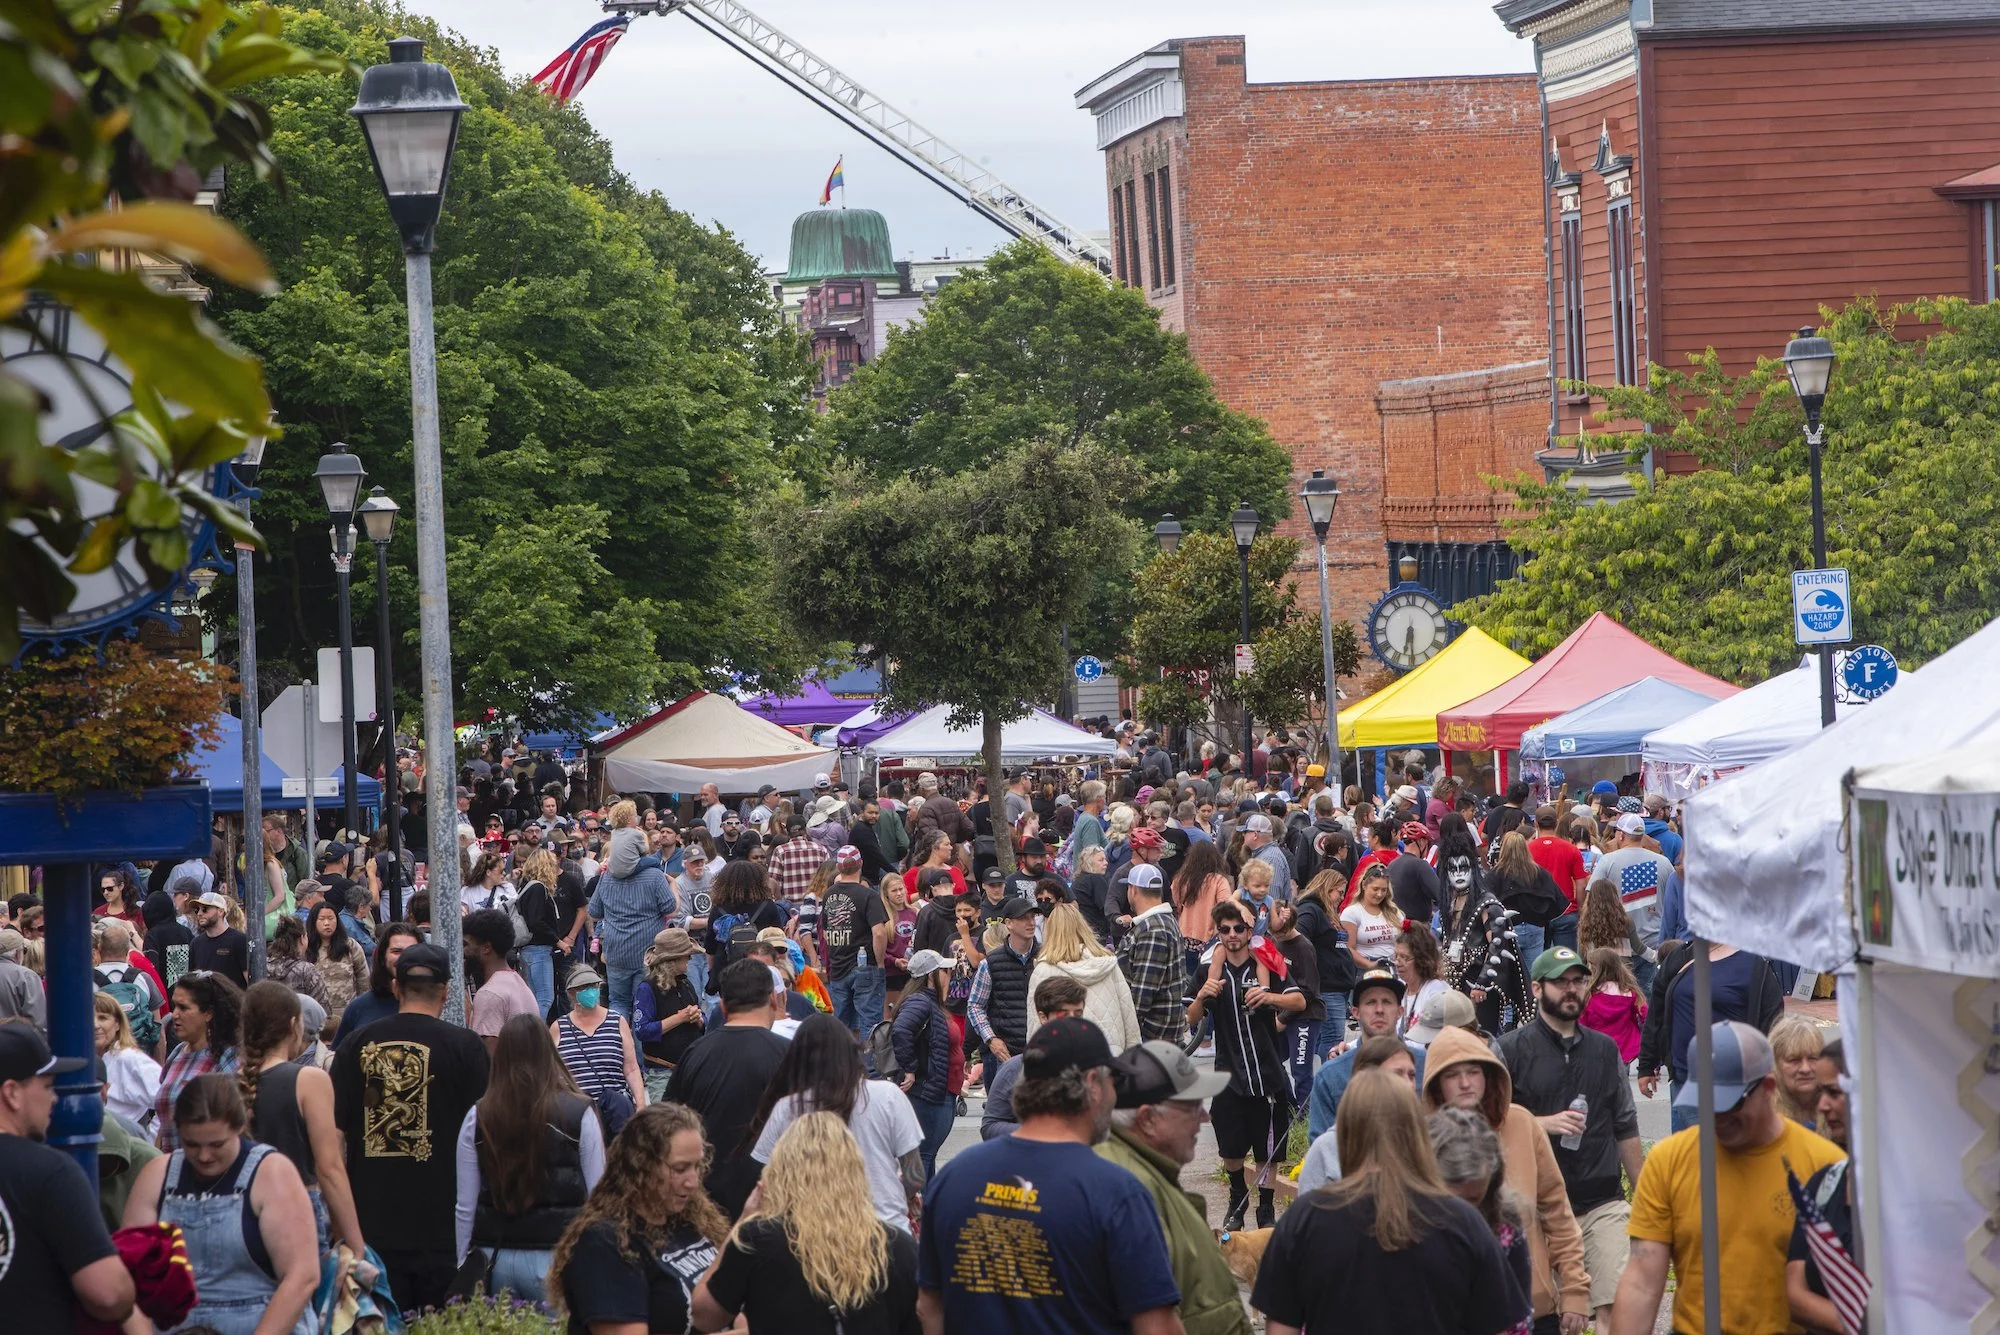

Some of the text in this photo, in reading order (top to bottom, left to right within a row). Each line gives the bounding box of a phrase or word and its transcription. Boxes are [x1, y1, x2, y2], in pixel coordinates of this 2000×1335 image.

[1797, 573, 1844, 586] ENTERING
[1808, 612, 1838, 622] HAZARD
[1813, 621, 1833, 630] ZONE
[1846, 648, 1895, 671] OLD TOWN
[1084, 663, 1093, 675] E
[1863, 662, 1878, 683] F
[1850, 682, 1892, 698] STREET
[825, 929, 852, 947] FIGHT
[1381, 928, 1392, 936] AS
[1367, 935, 1393, 944] APPLE
[1296, 1036, 1308, 1065] Hurley
